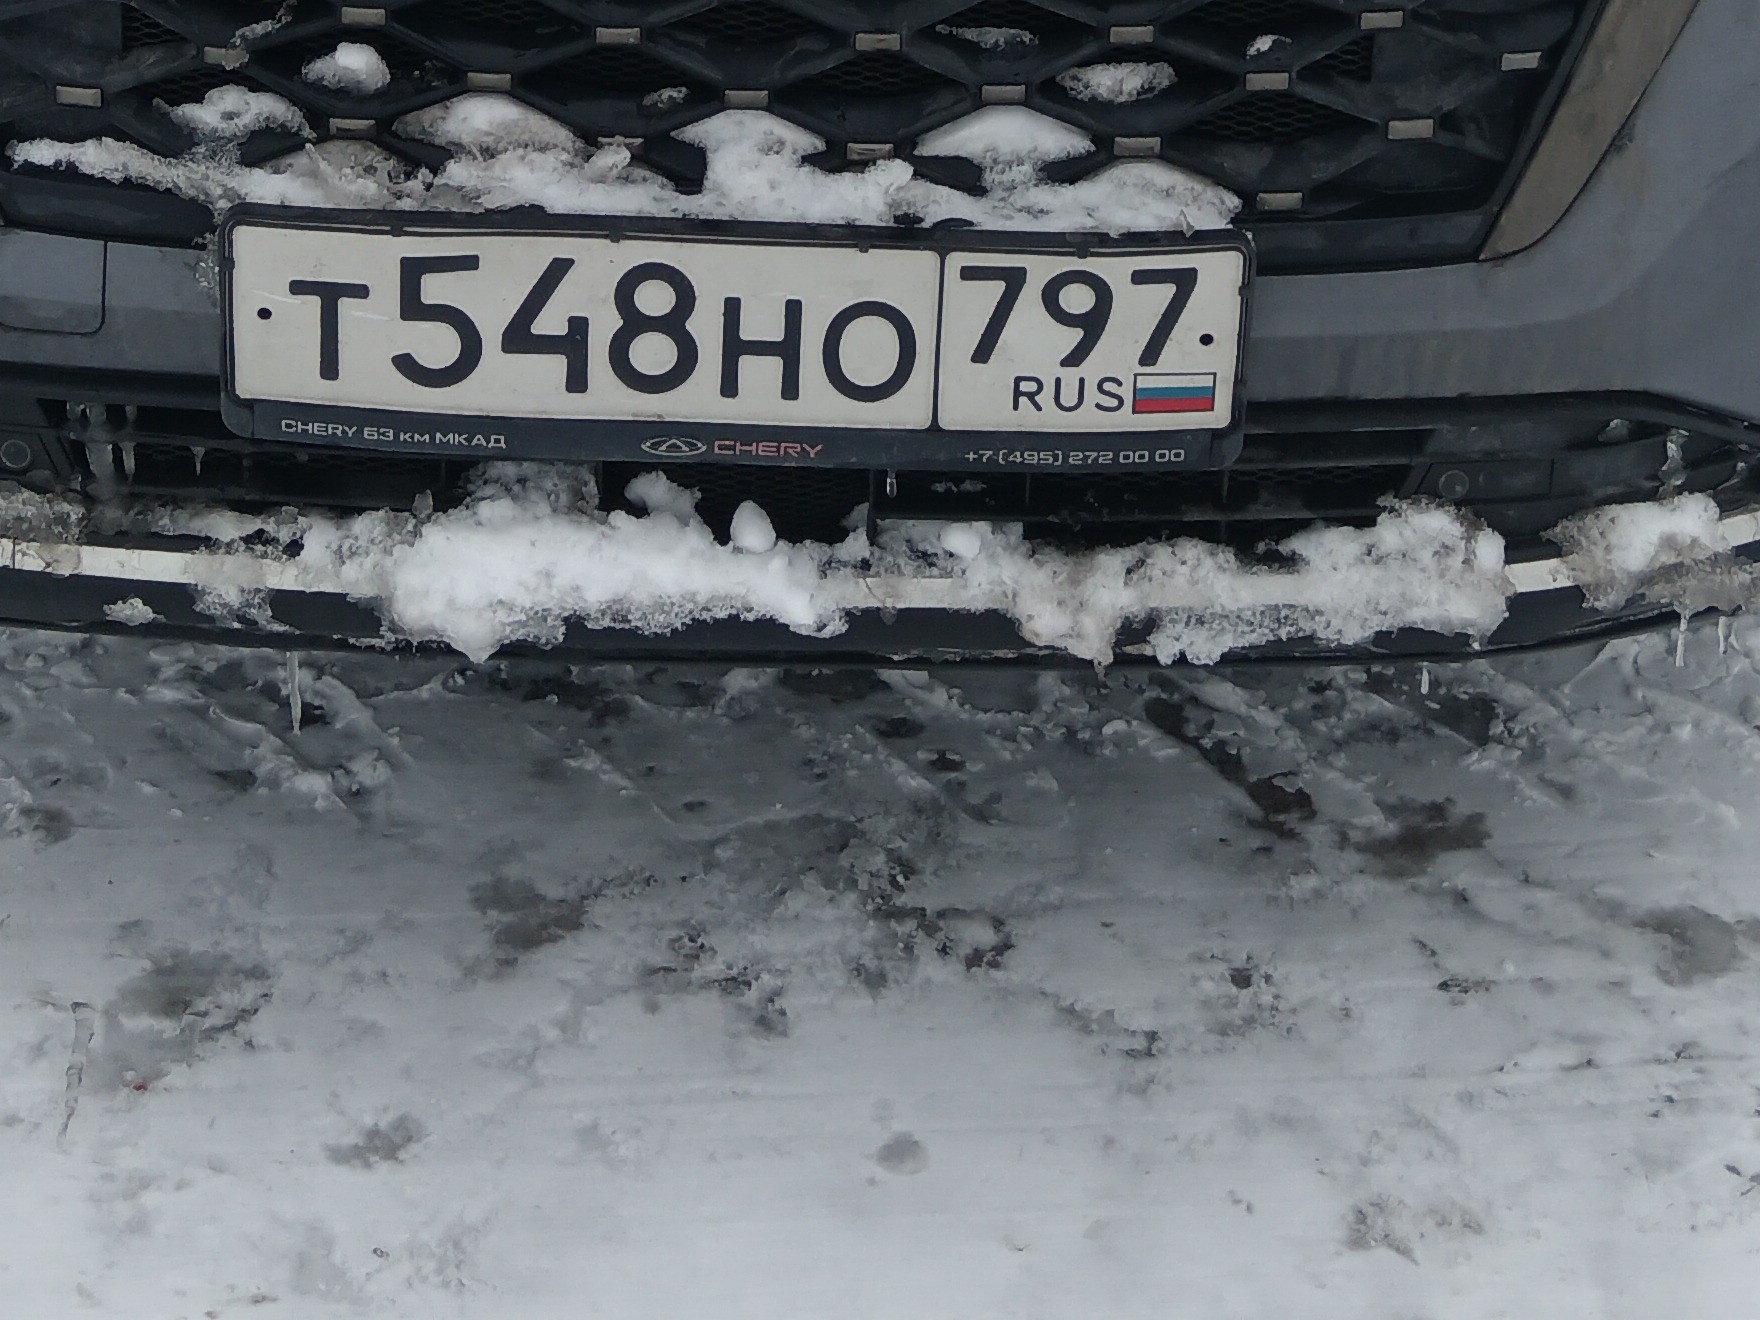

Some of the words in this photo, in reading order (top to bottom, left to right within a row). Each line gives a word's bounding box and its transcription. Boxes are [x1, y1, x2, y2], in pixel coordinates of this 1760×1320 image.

[289, 254, 917, 403] Т548НО
[959, 265, 1198, 368] 797
[1013, 375, 1124, 413] RUS
[280, 419, 358, 438] CHERY
[363, 426, 394, 441] 63
[399, 431, 430, 444] км
[435, 431, 507, 449] МКАД
[713, 439, 824, 458] CHERY
[998, 449, 1063, 466] (495)
[1068, 451, 1114, 465] 272
[1118, 450, 1149, 464] 00
[1154, 448, 1185, 463] 00
